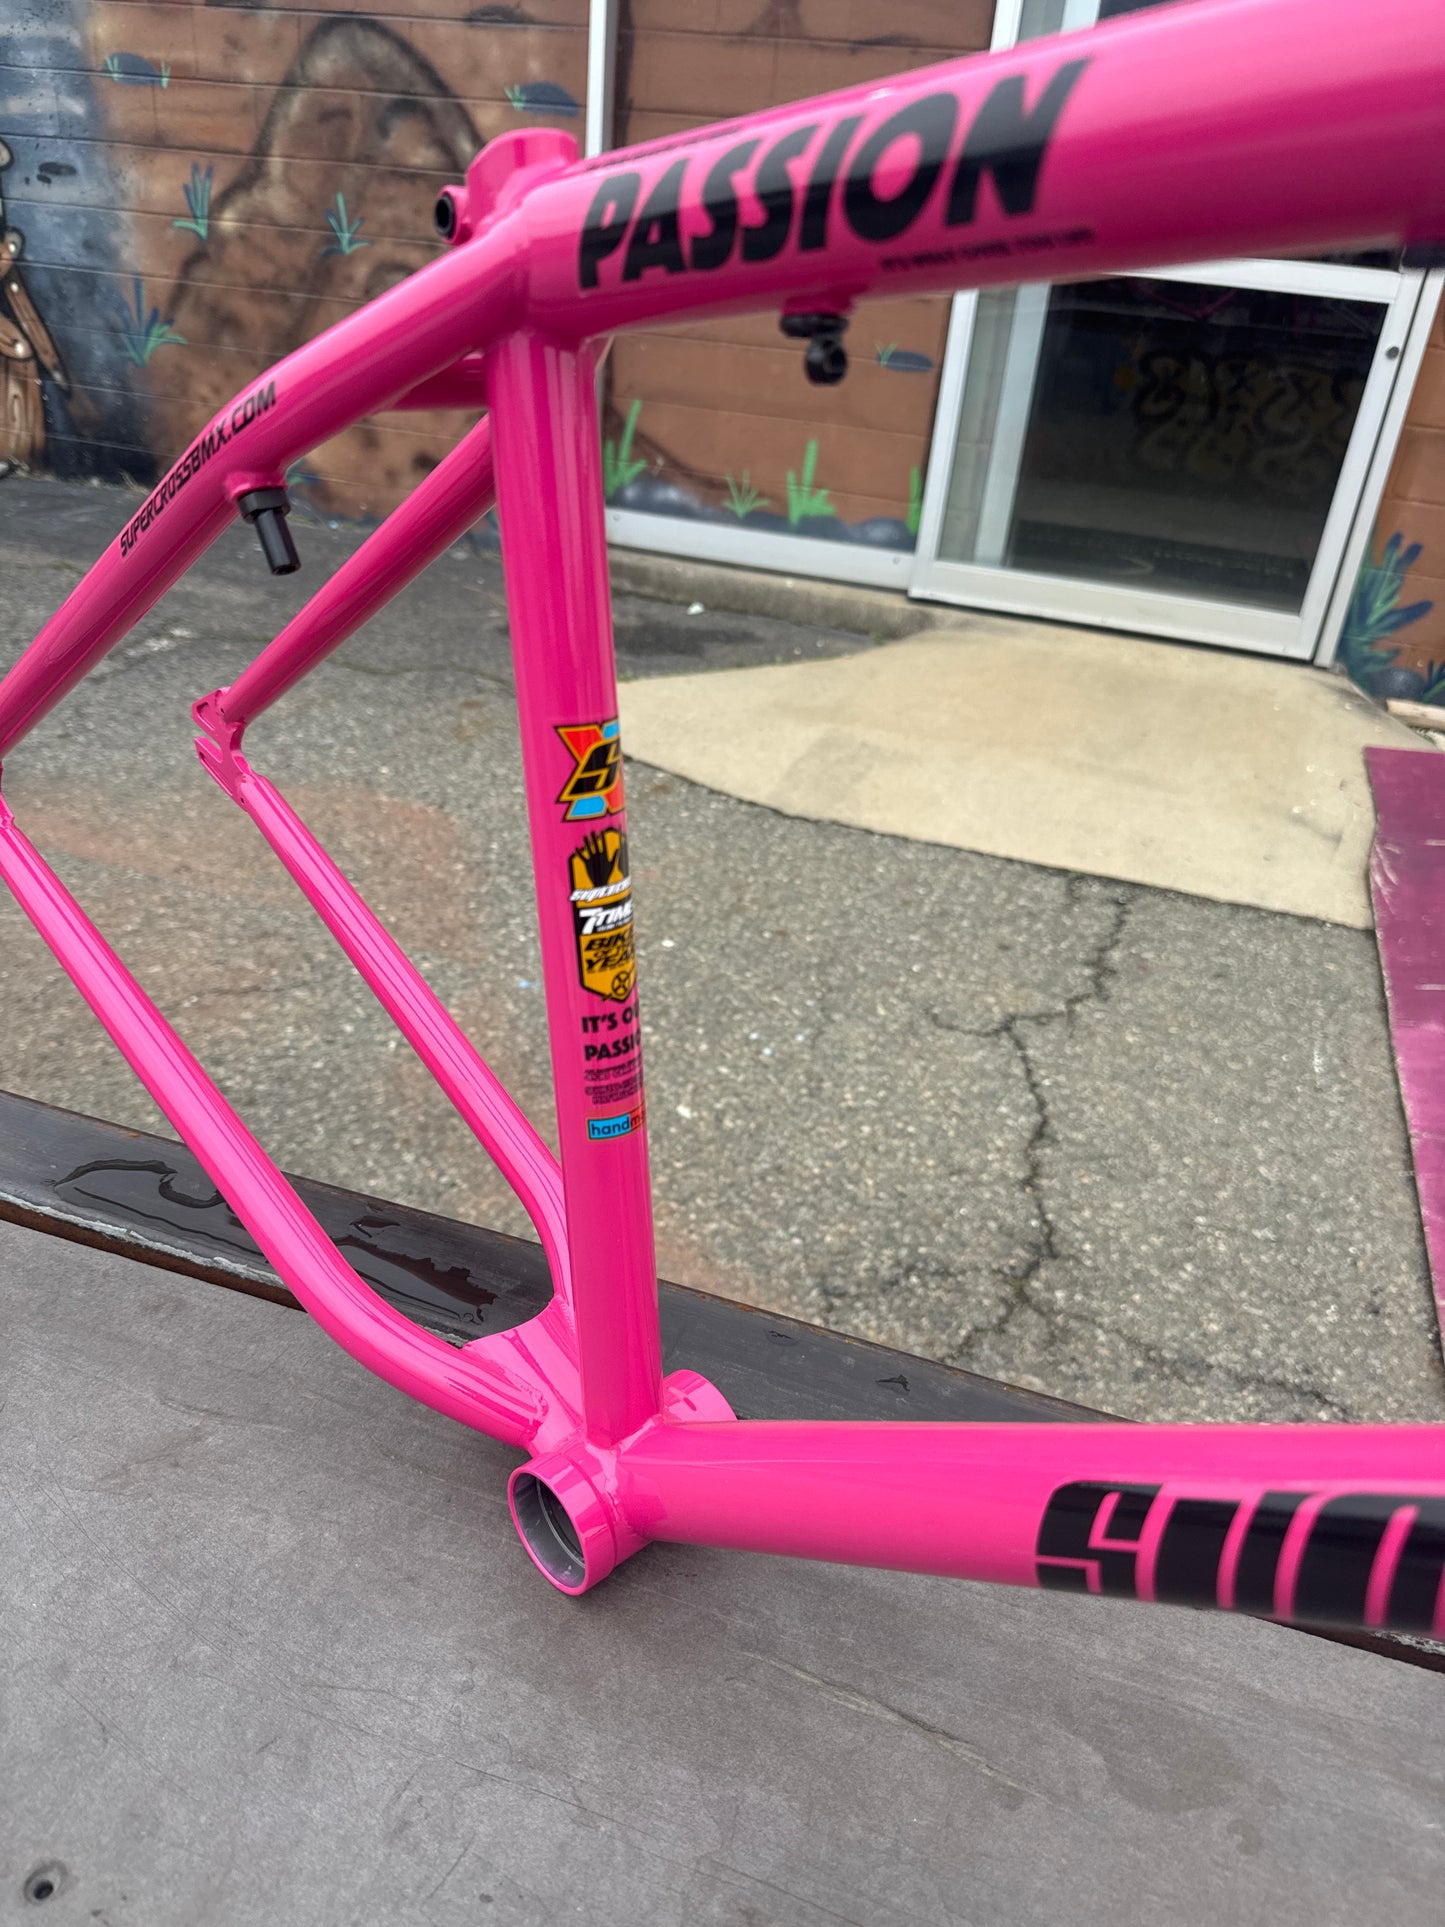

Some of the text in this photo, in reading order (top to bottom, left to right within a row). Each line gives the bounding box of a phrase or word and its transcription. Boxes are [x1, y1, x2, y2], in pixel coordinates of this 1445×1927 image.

[579, 57, 1093, 290] PASSION
[120, 381, 276, 557] SUPERCROSSBMX.COM
[582, 1012, 618, 1034] IT'S
